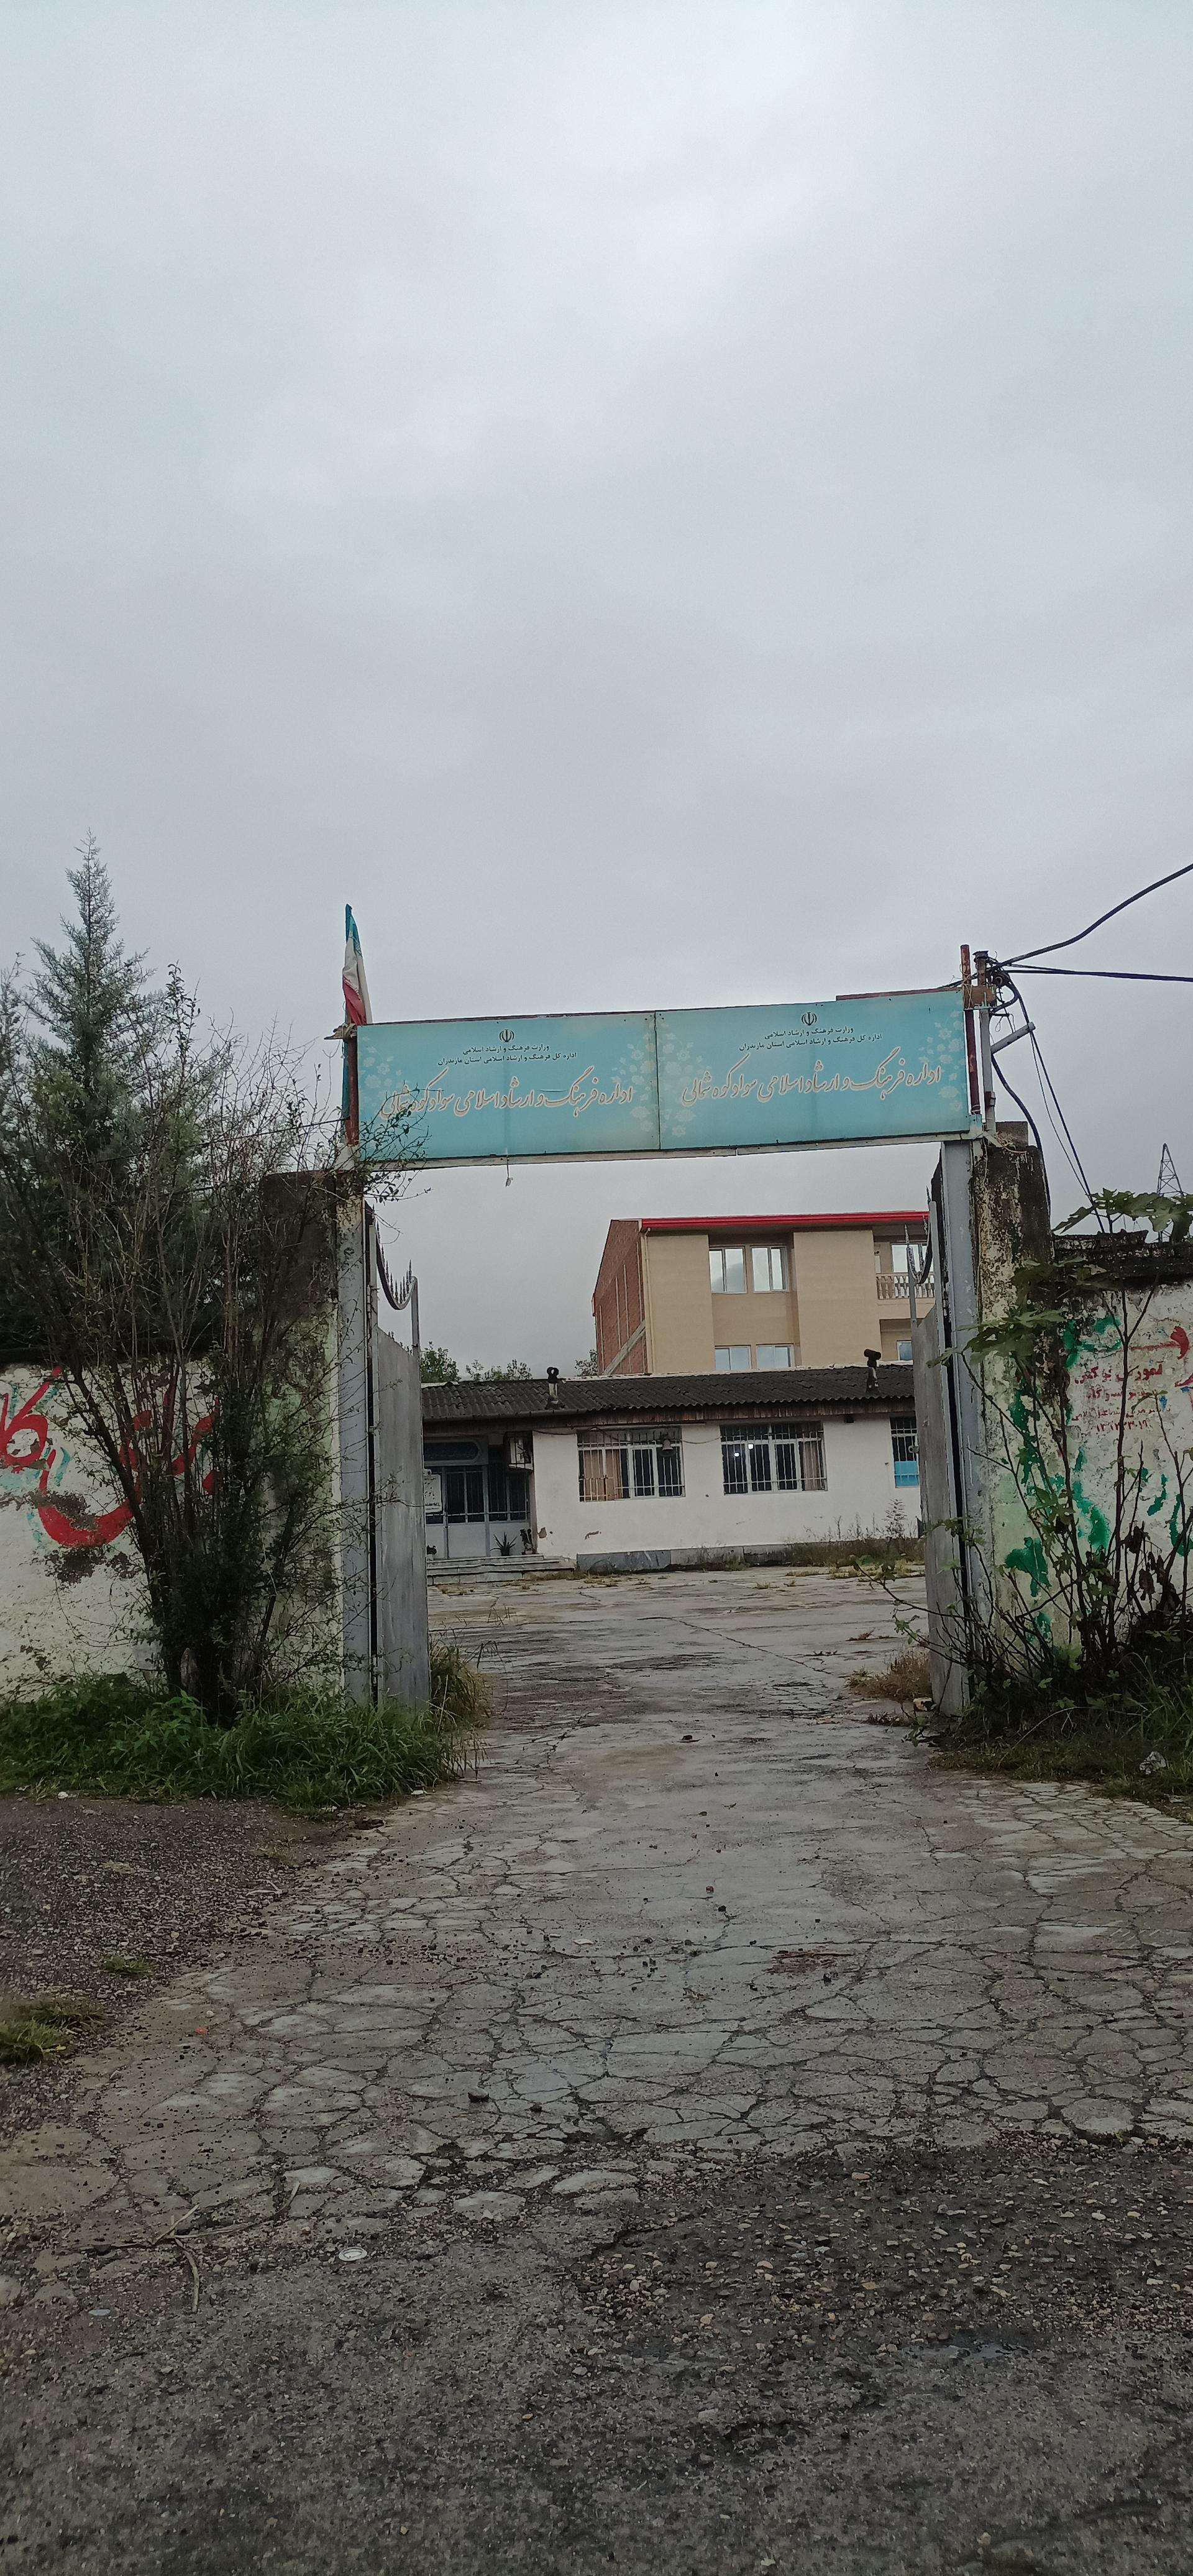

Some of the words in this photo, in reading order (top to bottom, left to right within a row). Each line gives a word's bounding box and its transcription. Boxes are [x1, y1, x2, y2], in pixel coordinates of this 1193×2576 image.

[788, 1029, 804, 1037] ارشاد
[835, 1025, 854, 1034] وزارت
[764, 1031, 786, 1040] اسلامی
[833, 1036, 855, 1044] فرهنگ
[857, 1034, 866, 1042] کل
[766, 1041, 784, 1050] استان
[786, 1039, 807, 1048] اسلامی
[809, 1037, 826, 1045] ارشاد
[462, 1047, 484, 1055] اسلامی
[485, 1045, 501, 1053] ارشاد
[739, 1042, 765, 1051] مازندران
[483, 1055, 505, 1064] اسلامی
[552, 1053, 562, 1061] کل
[563, 1052, 577, 1060] اداره
[437, 1058, 463, 1066] مازندران
[464, 1057, 482, 1065] استان
[805, 1060, 839, 1093] ارشاد
[850, 1047, 905, 1100] فرهنگ
[907, 1063, 941, 1085] اداره
[757, 1073, 804, 1102] اسلامی
[841, 1077, 850, 1091] و
[500, 1076, 534, 1108] ارشاد
[545, 1066, 599, 1116] فرهنگ
[599, 1083, 633, 1104] اداره
[454, 1089, 500, 1117] اسلامی
[536, 1093, 544, 1106] و
